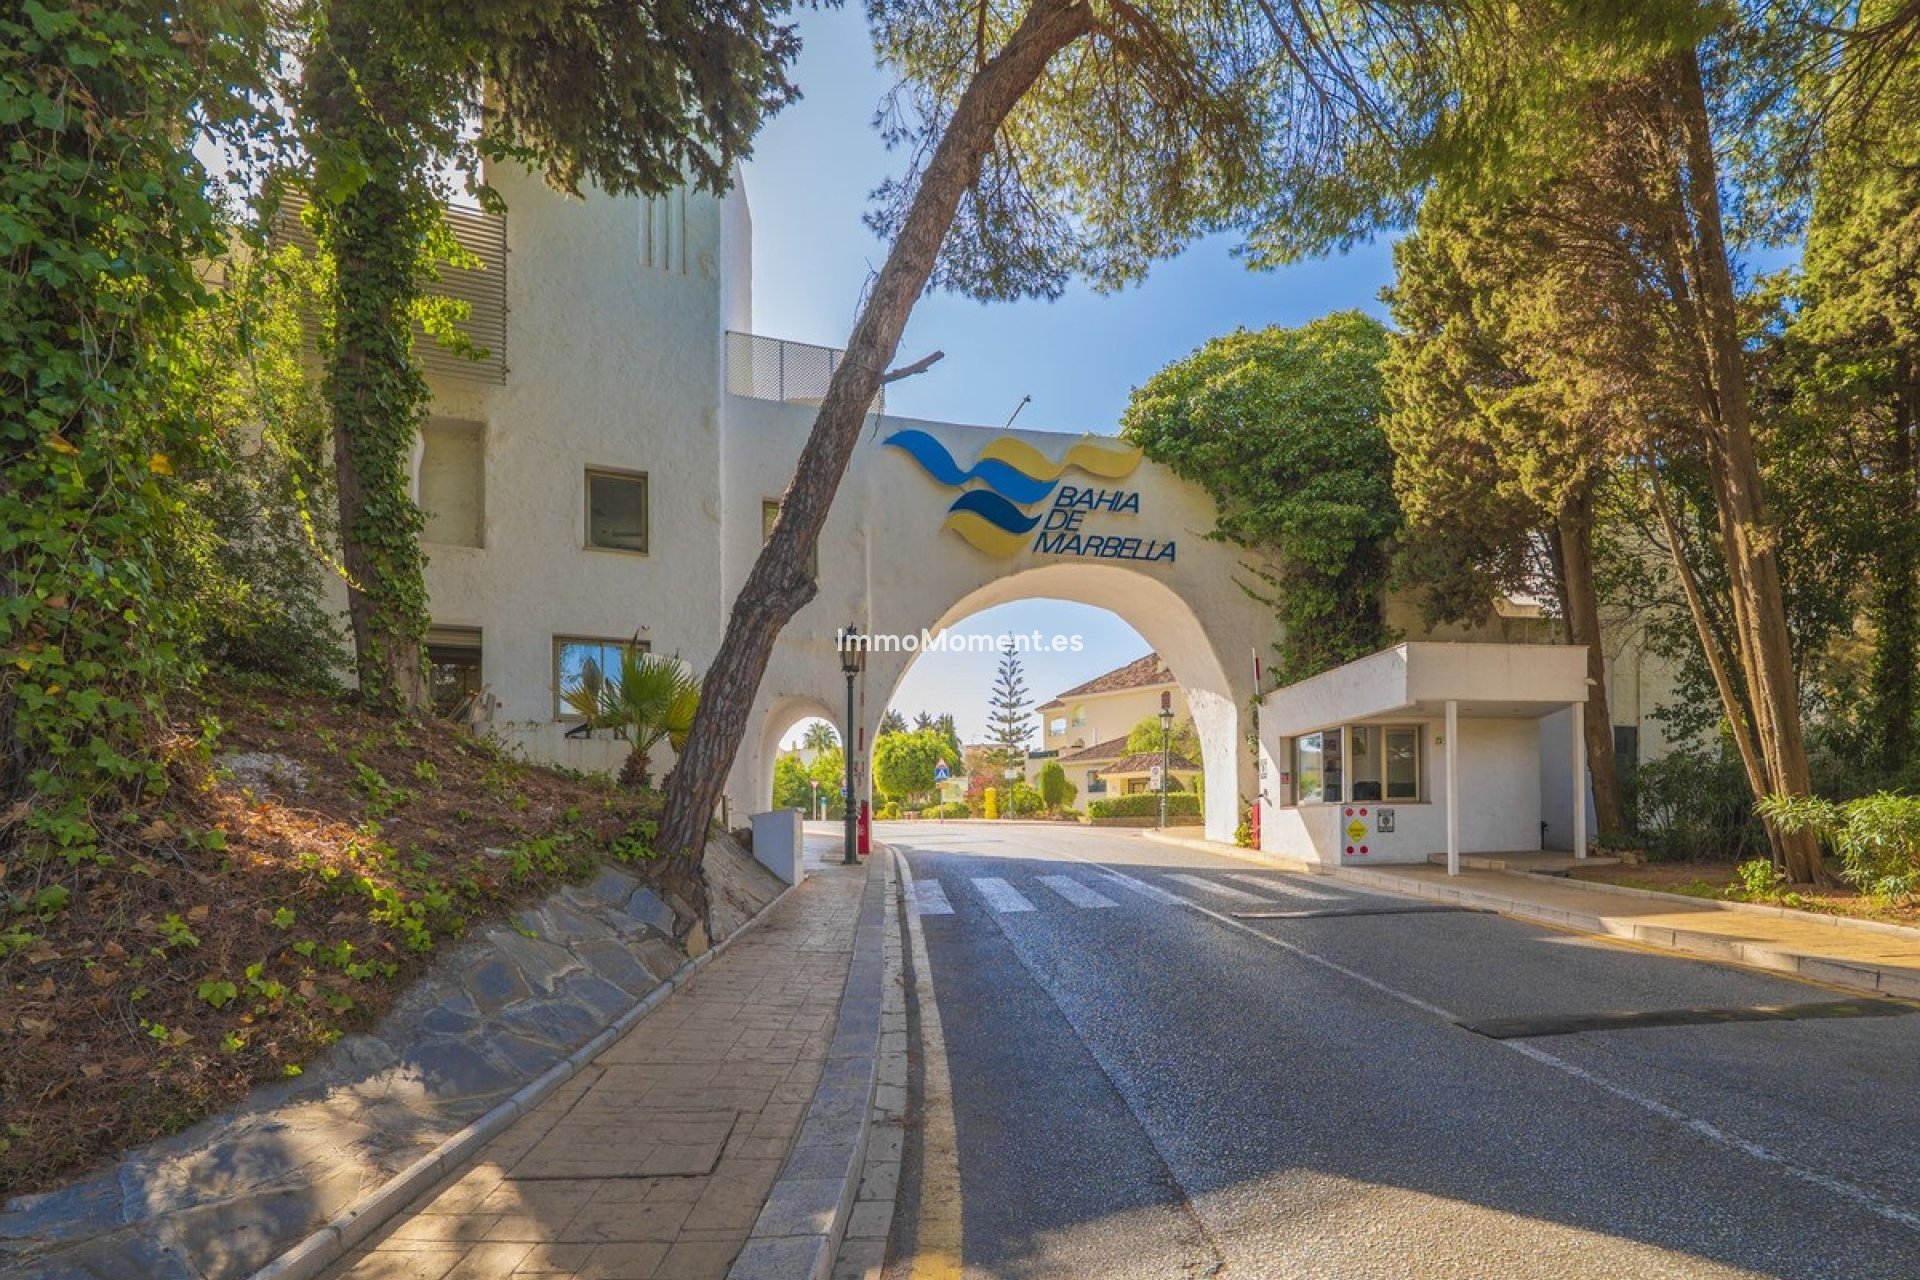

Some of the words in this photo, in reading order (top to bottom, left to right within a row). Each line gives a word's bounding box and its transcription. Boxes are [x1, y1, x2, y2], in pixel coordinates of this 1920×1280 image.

[1054, 486, 1139, 514] BAHIA
[1043, 508, 1086, 531] DE
[1032, 531, 1176, 563] MARBELLA
